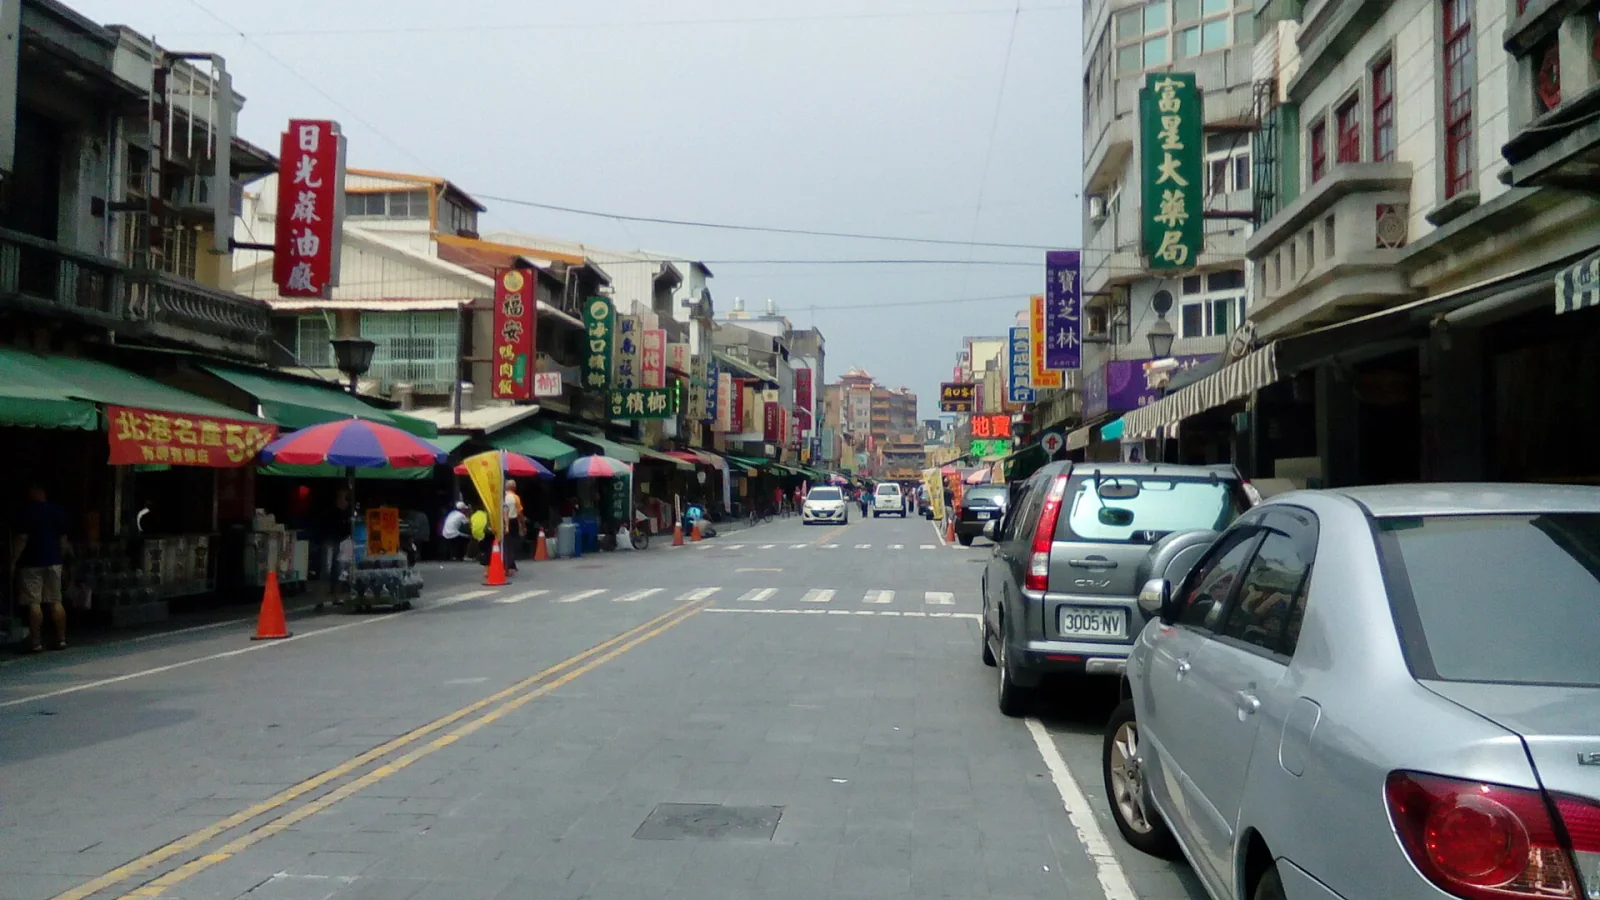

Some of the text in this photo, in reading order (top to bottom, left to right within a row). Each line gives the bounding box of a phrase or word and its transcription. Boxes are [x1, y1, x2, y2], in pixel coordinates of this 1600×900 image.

[1154, 77, 1190, 266] 富星大藥局
[1056, 269, 1079, 350] 寶芝林
